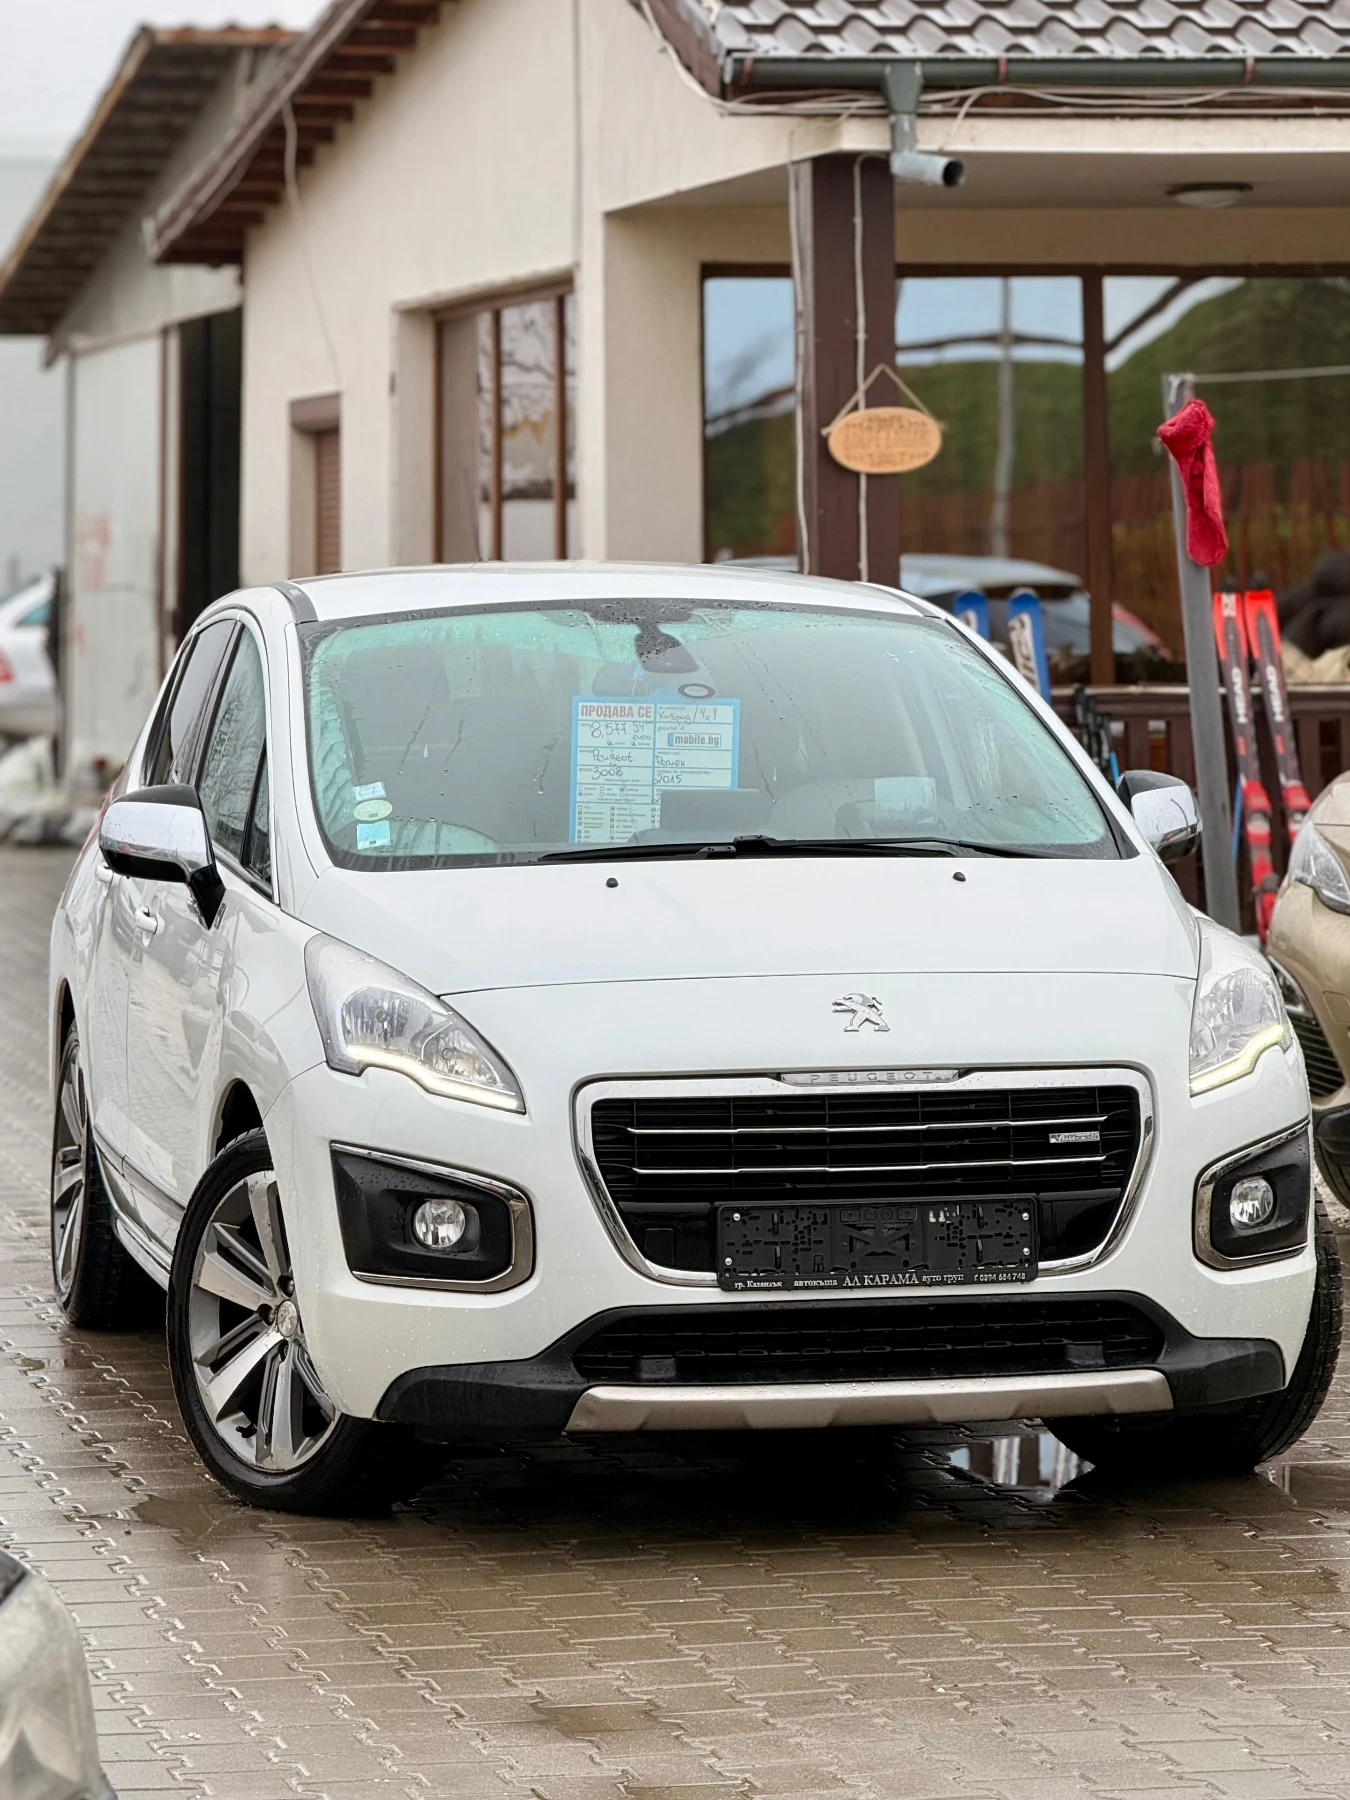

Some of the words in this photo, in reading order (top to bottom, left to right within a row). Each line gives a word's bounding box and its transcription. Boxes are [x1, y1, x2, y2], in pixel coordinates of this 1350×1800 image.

[580, 705, 634, 718] ПРОДАВА
[637, 705, 652, 718] СЕ
[675, 735, 719, 746] mobile.bg
[592, 748, 634, 767] Peugeot
[652, 773, 682, 784] 2015
[810, 1072, 933, 1083] PEUGEOT
[734, 1282, 746, 1290] гр.
[746, 1280, 783, 1288] Казанлък
[842, 1275, 861, 1287] АЛ
[863, 1273, 920, 1286] КАРАМА
[922, 1275, 942, 1283] ауто
[943, 1274, 964, 1283] груп
